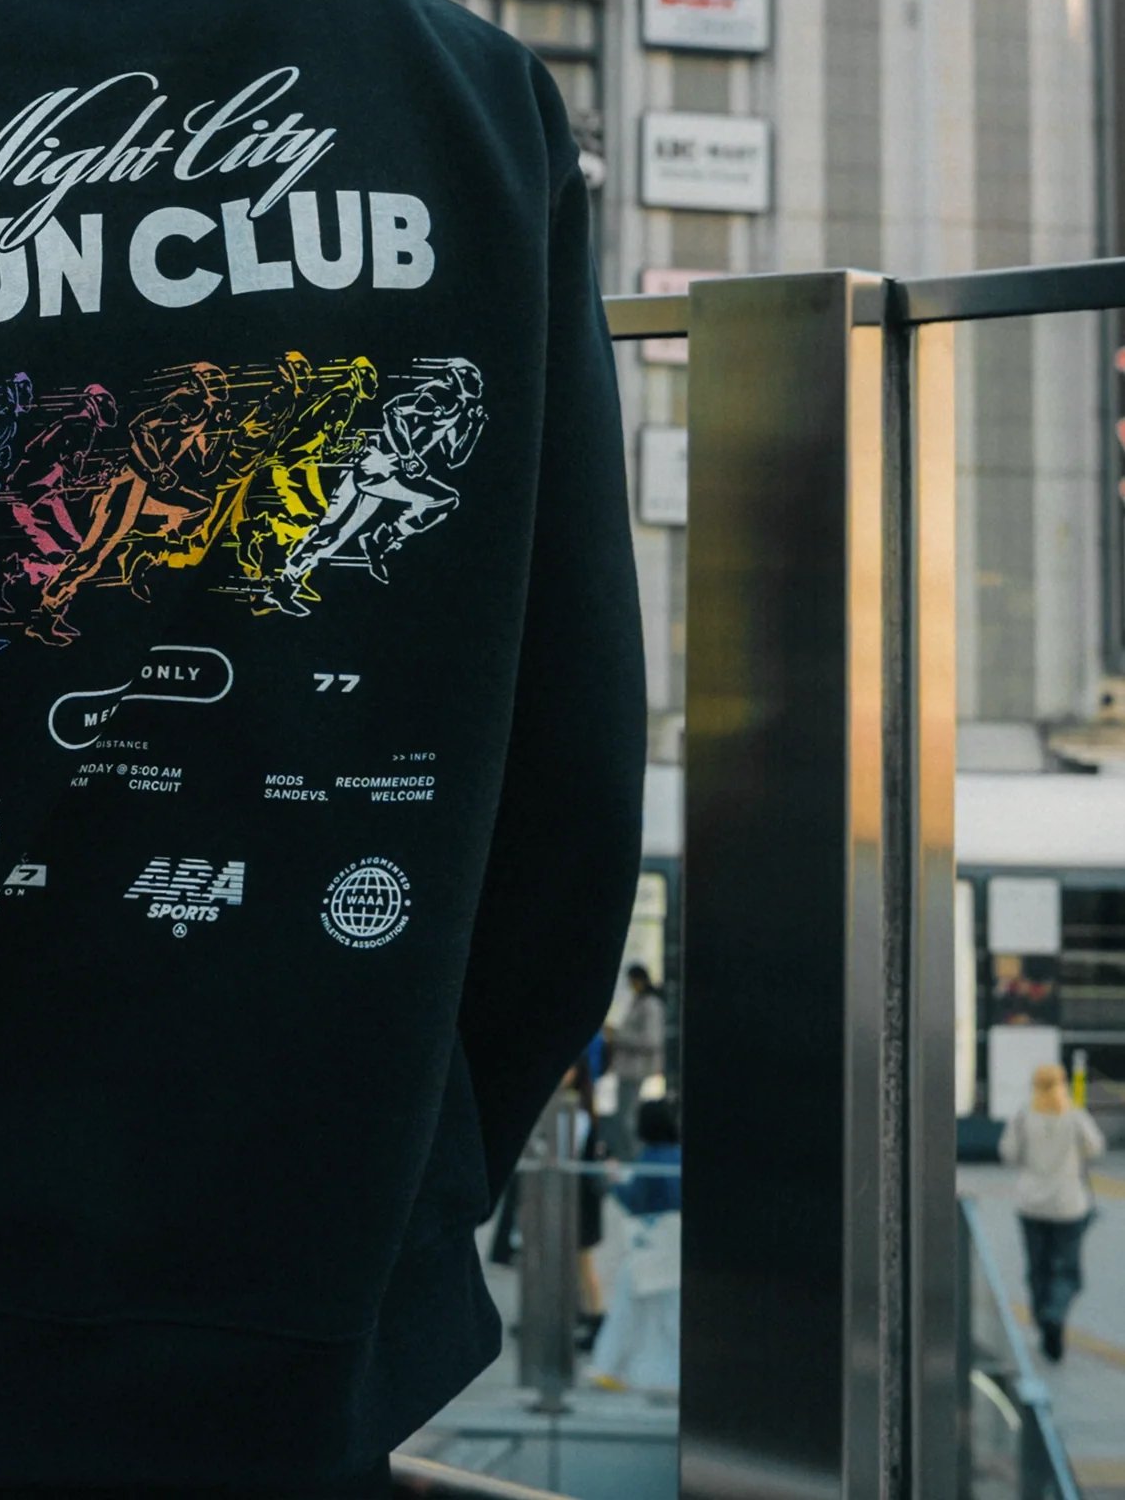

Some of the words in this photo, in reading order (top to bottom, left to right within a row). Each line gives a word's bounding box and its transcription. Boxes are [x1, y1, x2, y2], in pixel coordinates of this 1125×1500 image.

[173, 66, 336, 218] City
[128, 190, 435, 308] CLUB
[141, 665, 200, 681] ONLY
[313, 673, 360, 693] 77
[96, 740, 149, 749] DISTANCE
[410, 752, 436, 761] INFO
[77, 764, 114, 774] NDAY
[130, 765, 158, 776] 5:00
[161, 767, 182, 778] AM
[129, 779, 182, 792] CIRCUIT
[265, 774, 304, 786] MODS
[335, 776, 435, 788] RECOMMENDED
[371, 790, 435, 801] WELCOME
[327, 863, 356, 892] WORLD
[360, 857, 410, 890] AUGMENTED
[347, 895, 384, 906] WAAA
[146, 903, 220, 921] SPORTS
[320, 912, 351, 946] ATHLETICS
[352, 915, 409, 949] ASSOCIATIONS
